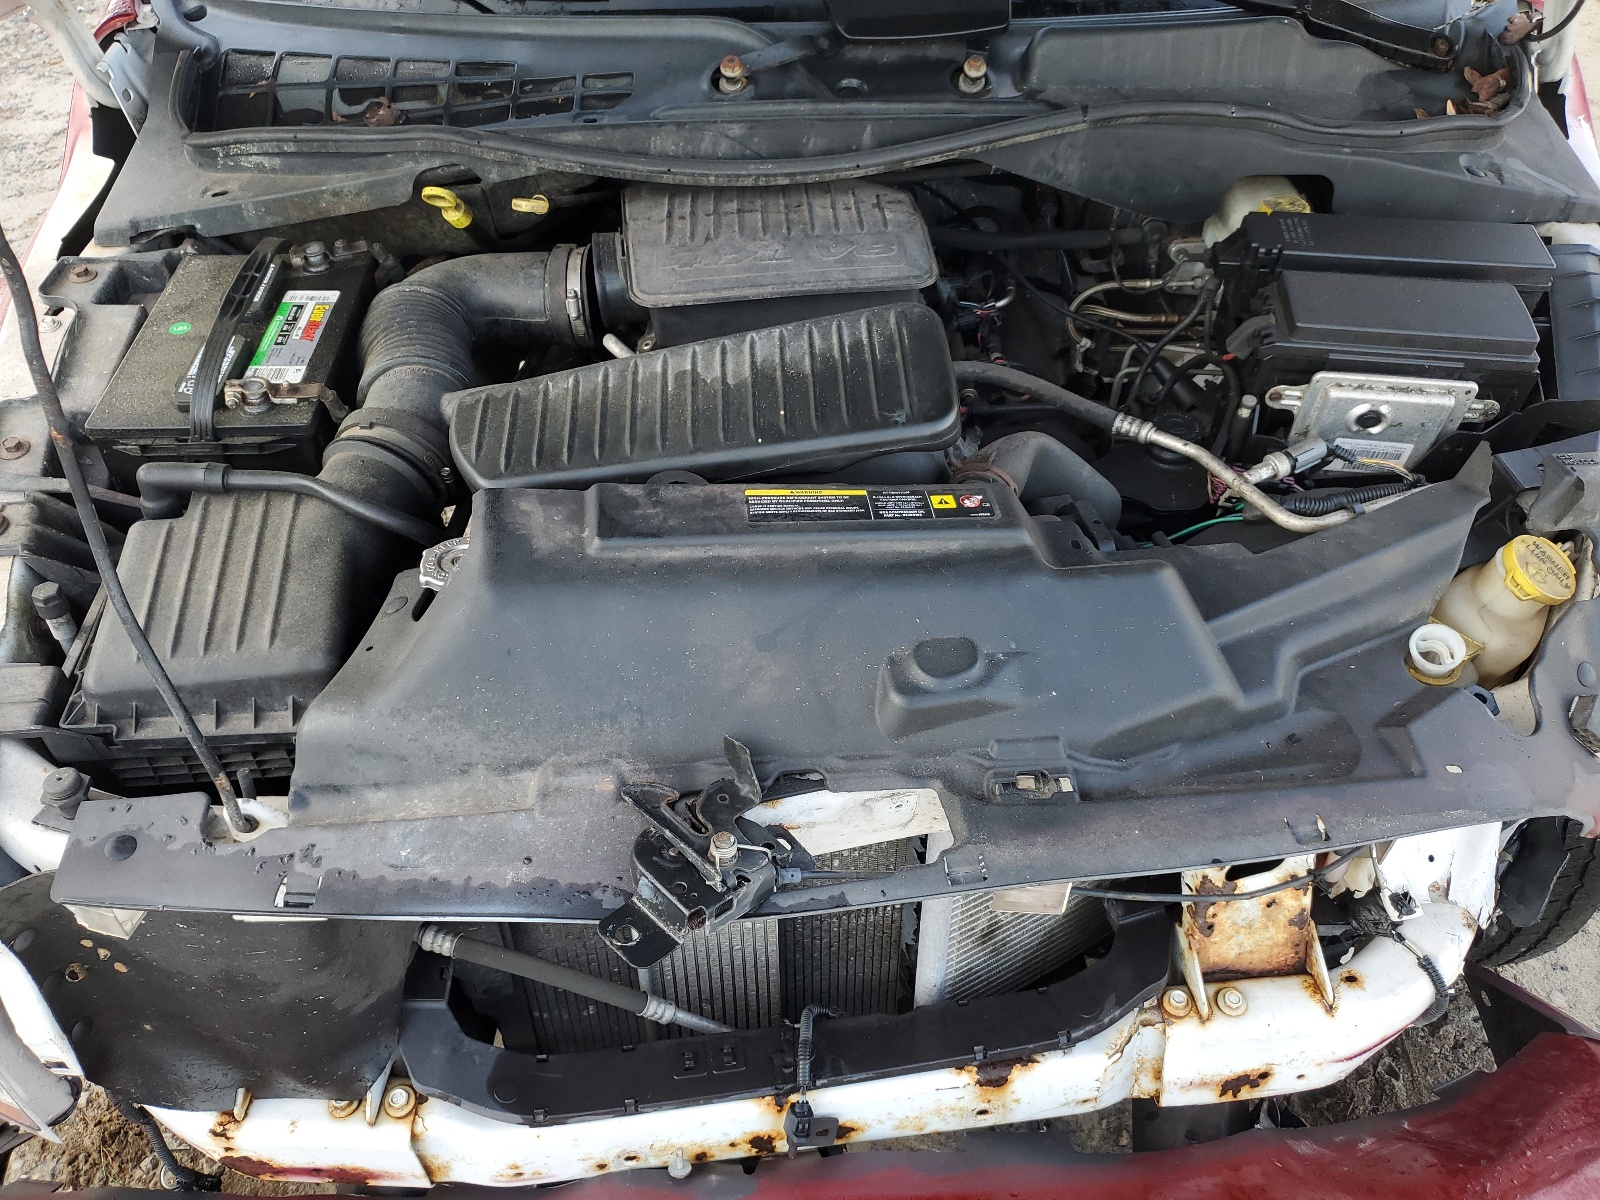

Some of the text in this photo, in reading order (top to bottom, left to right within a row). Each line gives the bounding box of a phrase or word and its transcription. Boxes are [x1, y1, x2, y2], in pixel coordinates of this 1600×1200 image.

[301, 304, 330, 342] EverStart
[1532, 540, 1570, 581] WASHER
[1547, 566, 1571, 590] ONLY
